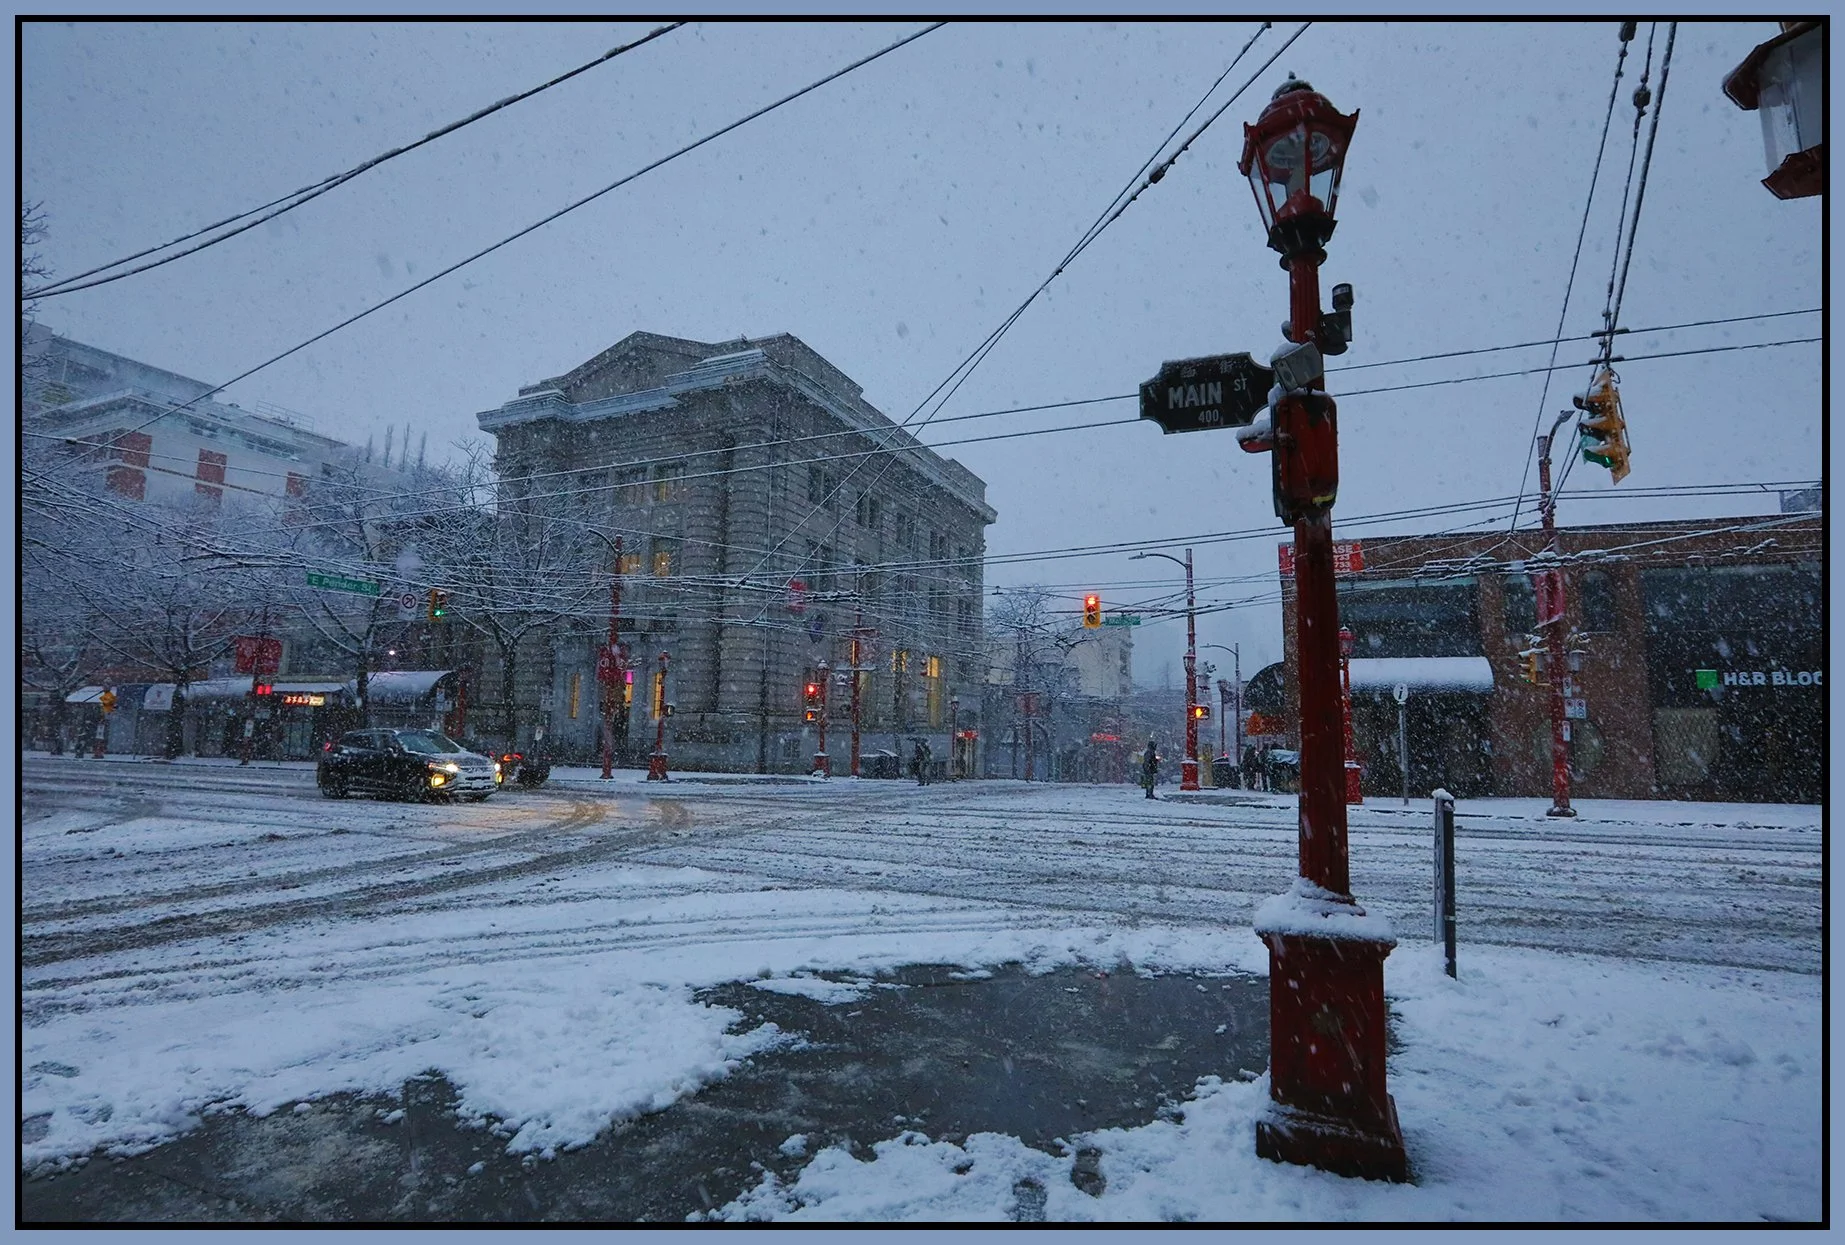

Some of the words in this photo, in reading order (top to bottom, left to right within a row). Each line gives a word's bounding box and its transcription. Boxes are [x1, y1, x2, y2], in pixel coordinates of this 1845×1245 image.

[1168, 381, 1222, 409] MAIN
[1198, 409, 1219, 423] 400
[311, 576, 319, 585] E
[322, 577, 357, 590] Pender
[1723, 671, 1766, 686] H&R
